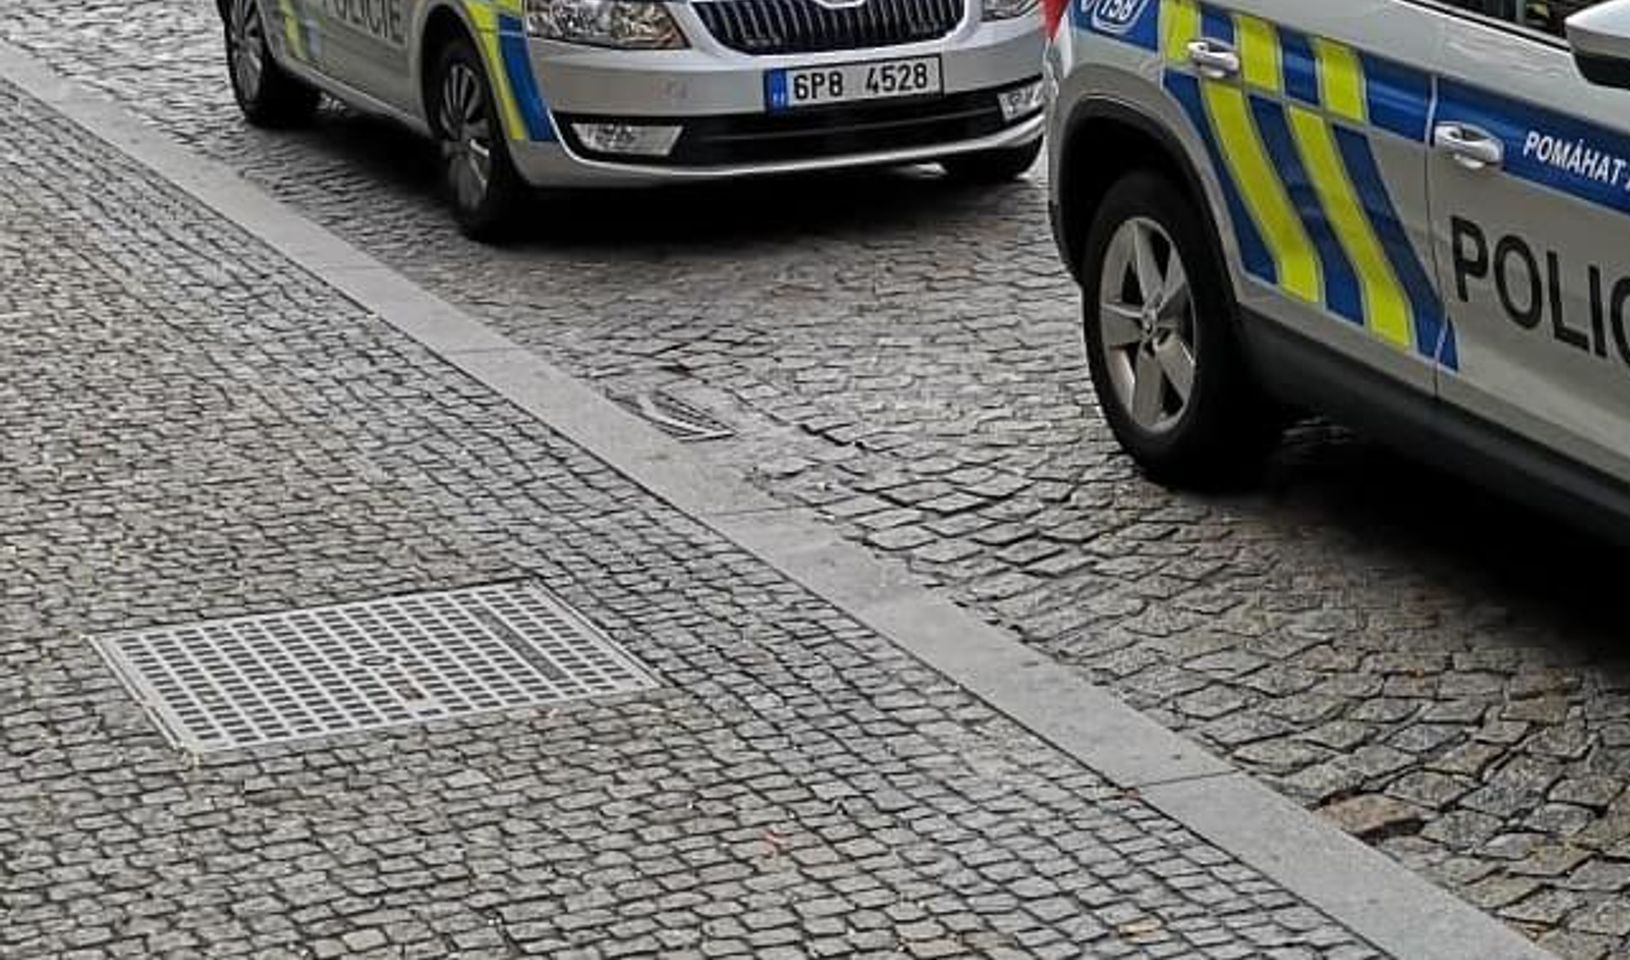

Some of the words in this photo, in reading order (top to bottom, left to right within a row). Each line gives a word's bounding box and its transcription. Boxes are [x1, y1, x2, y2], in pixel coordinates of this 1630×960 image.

[793, 71, 843, 100] 6P8
[866, 62, 928, 94] 4528
[1523, 130, 1627, 186] POMÁHAT
